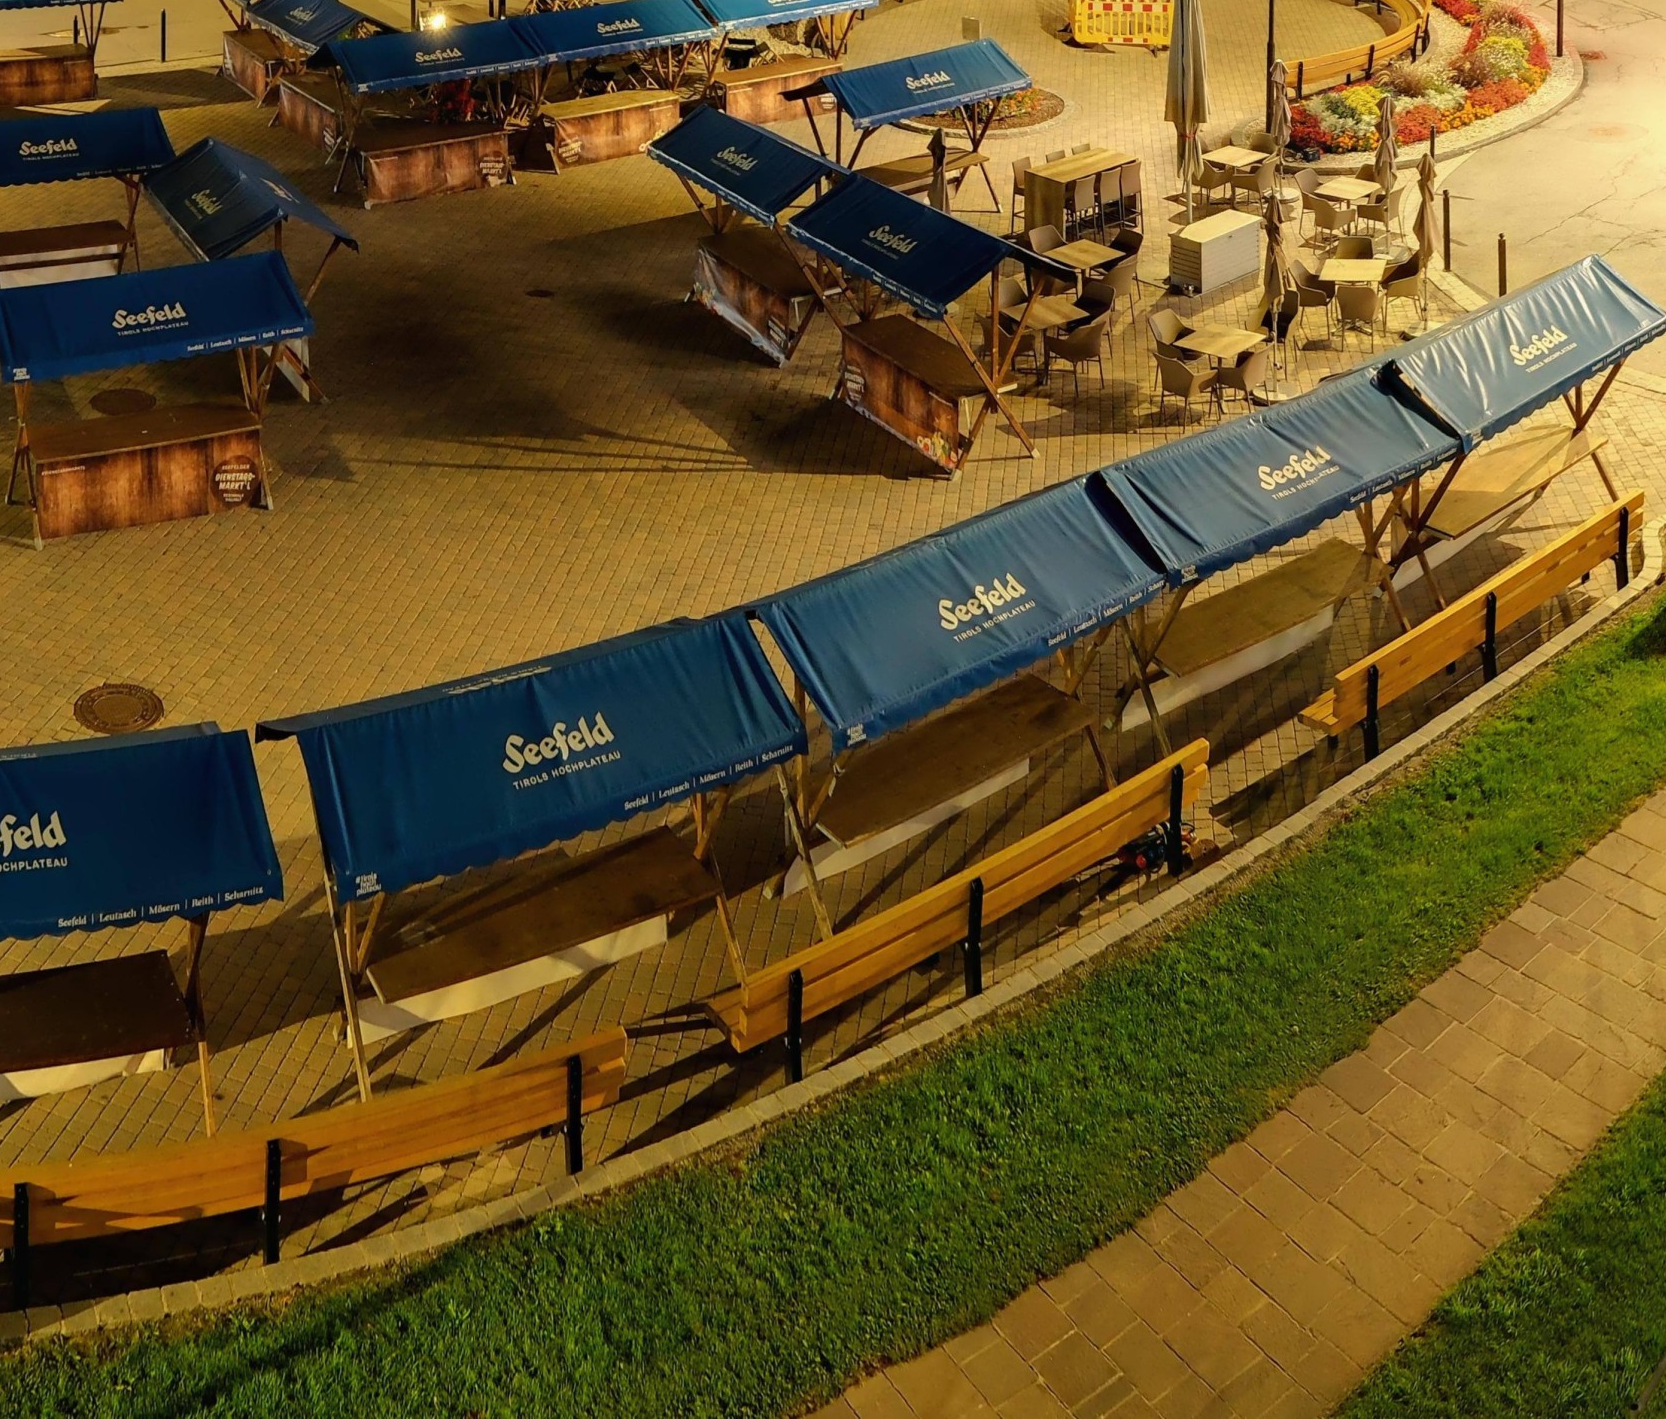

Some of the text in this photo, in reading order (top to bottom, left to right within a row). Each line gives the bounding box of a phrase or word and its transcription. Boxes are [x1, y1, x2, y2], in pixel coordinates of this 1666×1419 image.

[597, 18, 641, 34] Seefeld
[415, 47, 463, 64] Seefeld
[906, 70, 951, 90] Seefeld
[19, 137, 78, 157] Seefeld
[716, 146, 759, 171] Seefeld
[869, 224, 918, 254] Seefeld
[112, 302, 186, 329] Seefeld
[1509, 324, 1568, 366] Seefeld
[1257, 444, 1331, 491] Seefeld
[1271, 486, 1296, 501] TIROLS
[938, 572, 1027, 630] Seefeld
[953, 599, 1036, 644] TIROLS HOCHPLATEAU
[1048, 631, 1067, 647] Seefeld
[501, 711, 615, 774] Seefeld
[513, 750, 621, 791] TIROLS HOCHPLATEAU
[624, 743, 794, 811] Seefeld Leutasch Mösern Reith Scharnitz
[57, 885, 264, 928] Seefeld Leutasch Mösern Reith Scharnitz
